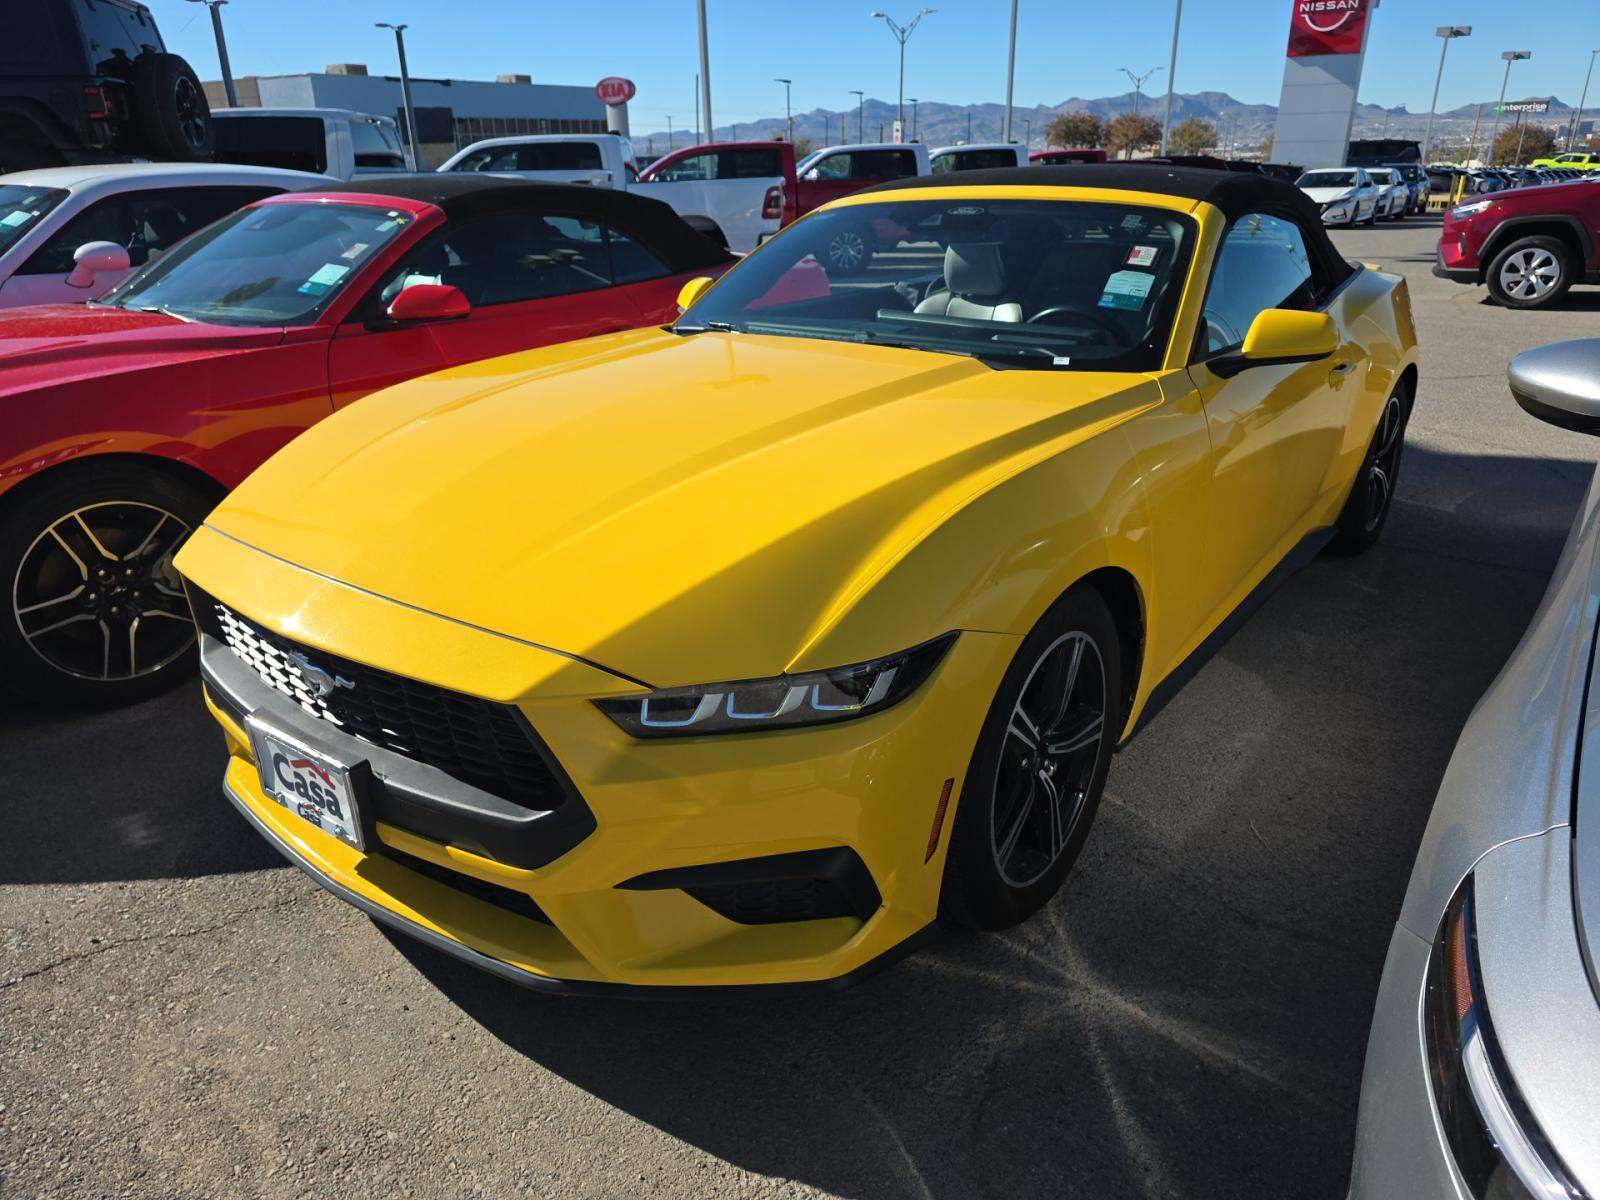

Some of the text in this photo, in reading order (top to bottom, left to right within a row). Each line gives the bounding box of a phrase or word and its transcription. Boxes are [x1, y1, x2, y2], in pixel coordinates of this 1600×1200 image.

[1300, 0, 1359, 12] NISSAN
[599, 82, 629, 98] KIA
[273, 753, 344, 821] Casa
